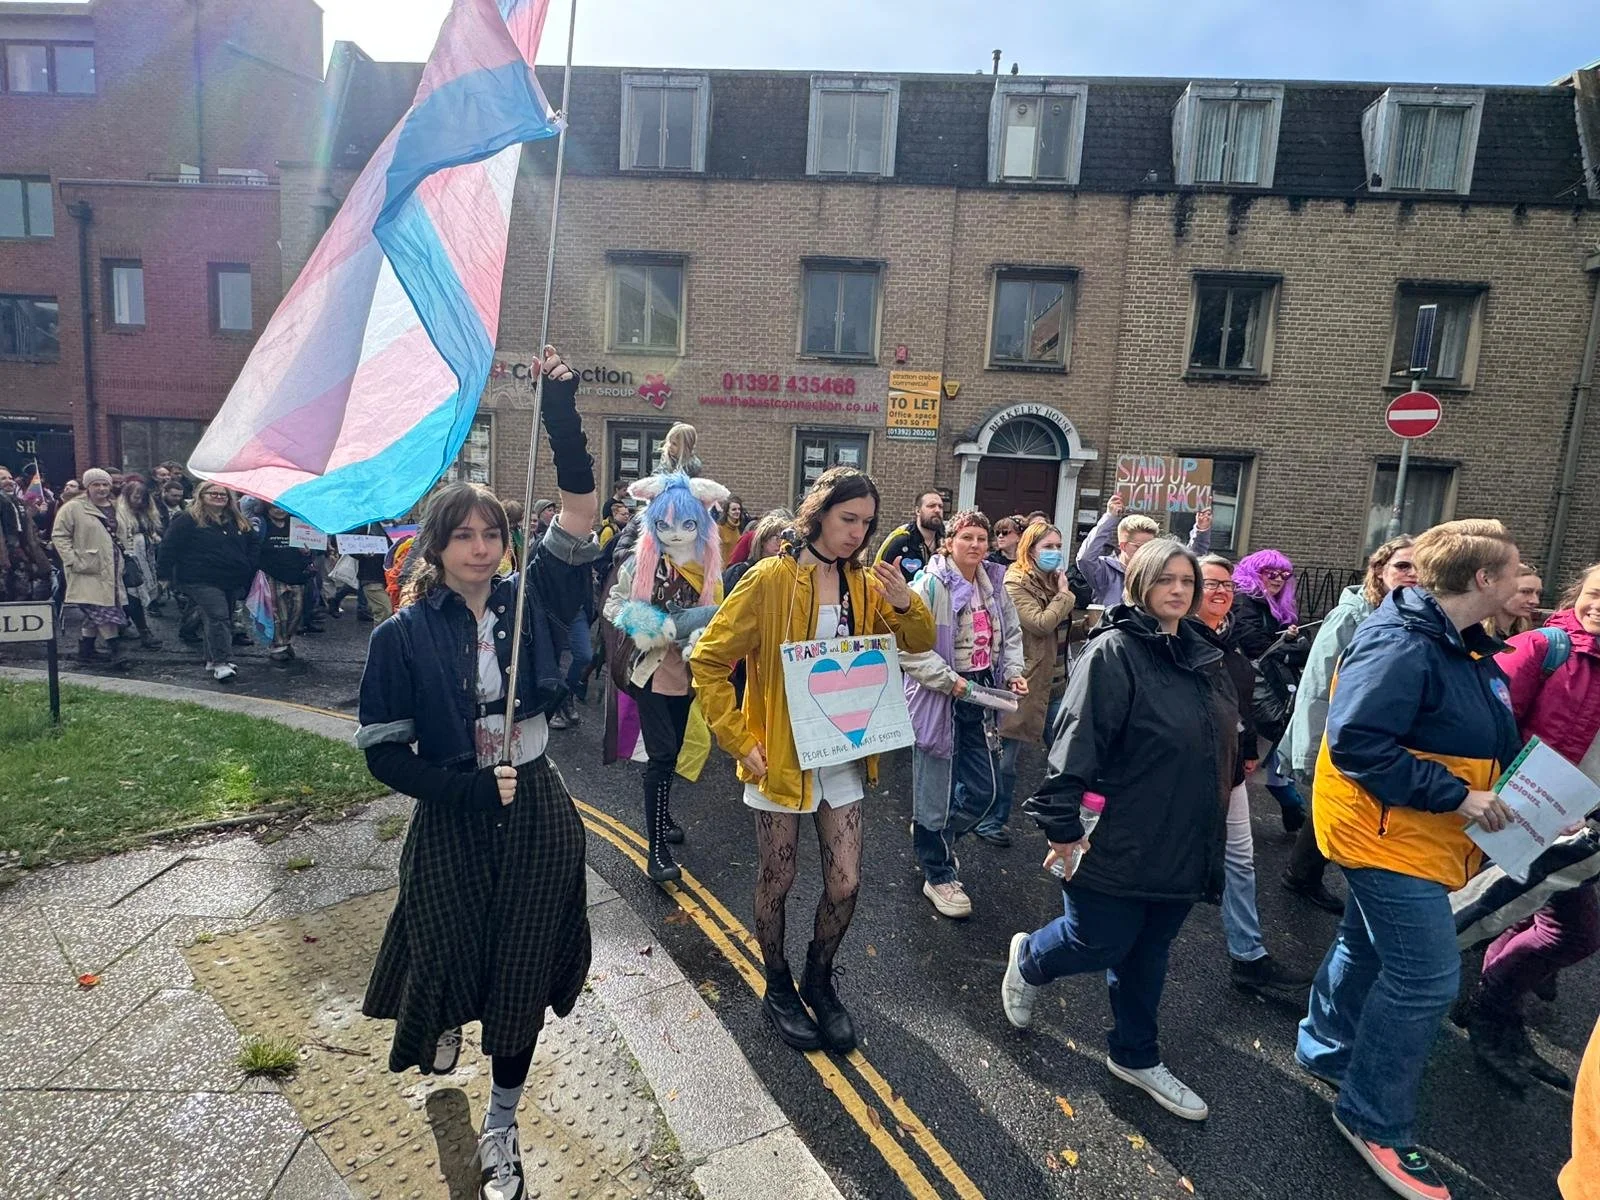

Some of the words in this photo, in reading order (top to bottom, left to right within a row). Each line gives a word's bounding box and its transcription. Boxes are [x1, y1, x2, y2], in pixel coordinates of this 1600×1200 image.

[512, 362, 633, 385] Cction
[722, 372, 780, 391] 01392
[785, 375, 856, 396] 435468
[596, 387, 635, 398] GROUP
[890, 397, 907, 409] TO
[914, 398, 938, 410] LET
[697, 395, 880, 413] www.thebestconnection.co.uk
[988, 405, 1041, 432] BERKELEY
[1044, 408, 1073, 436] HOUSE
[887, 428, 912, 436] (01392)
[16, 439, 36, 453] SH
[1117, 454, 1166, 483] STAND
[1116, 482, 1164, 512] FIGHT
[0, 615, 44, 633] LD
[783, 641, 828, 662] TRANS
[829, 645, 840, 653] and
[802, 748, 829, 763] PEOPLE
[831, 744, 849, 755] HAVE
[851, 736, 876, 750] AWAYS
[879, 729, 901, 743] EXISTED
[1518, 773, 1537, 789] see
[1534, 786, 1556, 804] your
